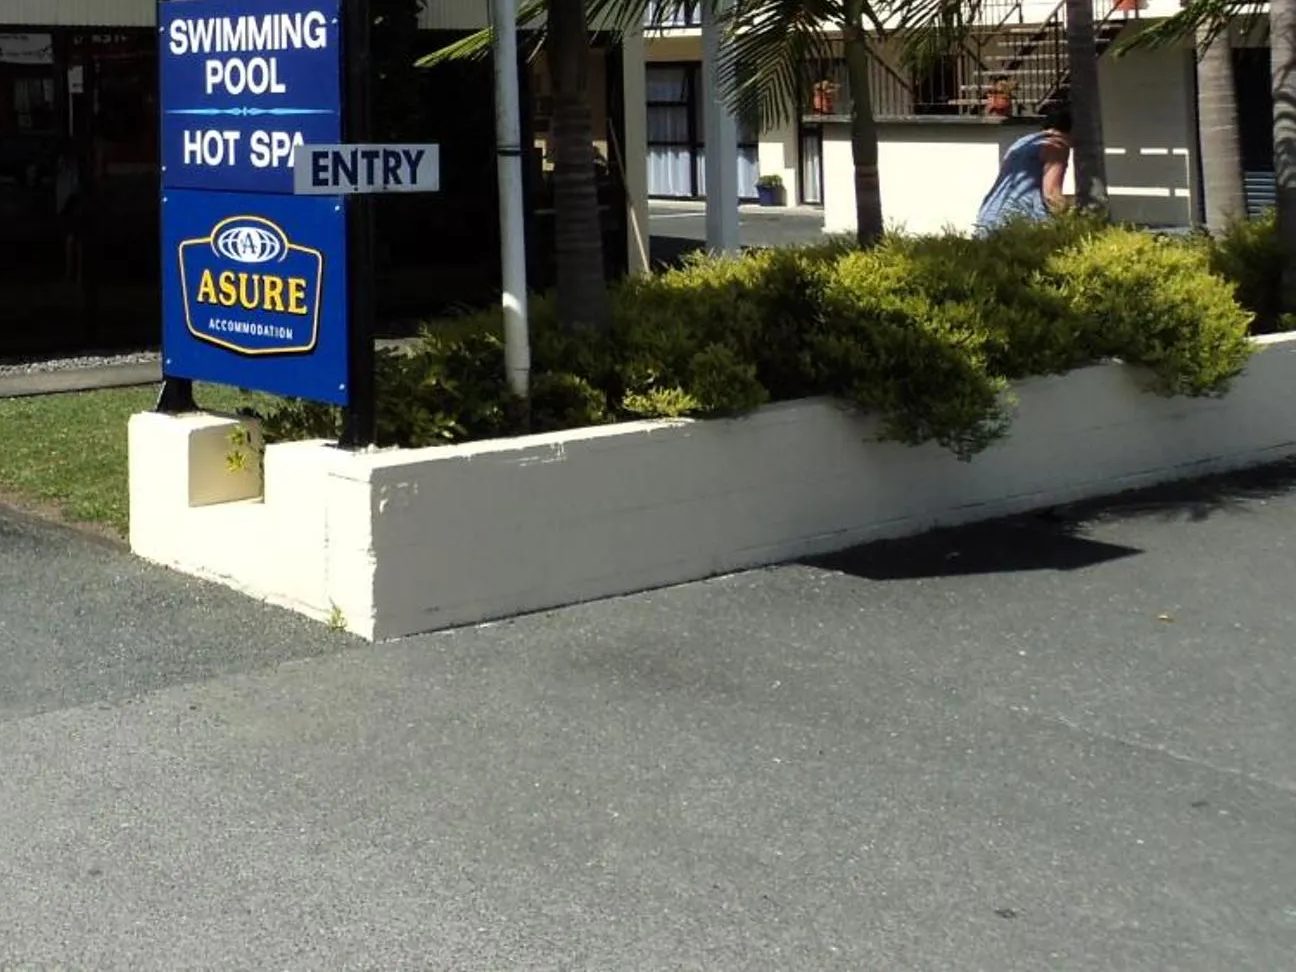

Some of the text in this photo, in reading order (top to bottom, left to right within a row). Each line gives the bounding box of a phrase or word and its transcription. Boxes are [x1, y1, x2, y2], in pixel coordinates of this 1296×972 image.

[169, 11, 327, 54] SWIMMING
[206, 57, 286, 95] POOL
[183, 130, 240, 166] HOT
[312, 148, 424, 187] ENTRY
[196, 269, 308, 314] ASURE
[208, 318, 294, 340] ACCOMMODATION
